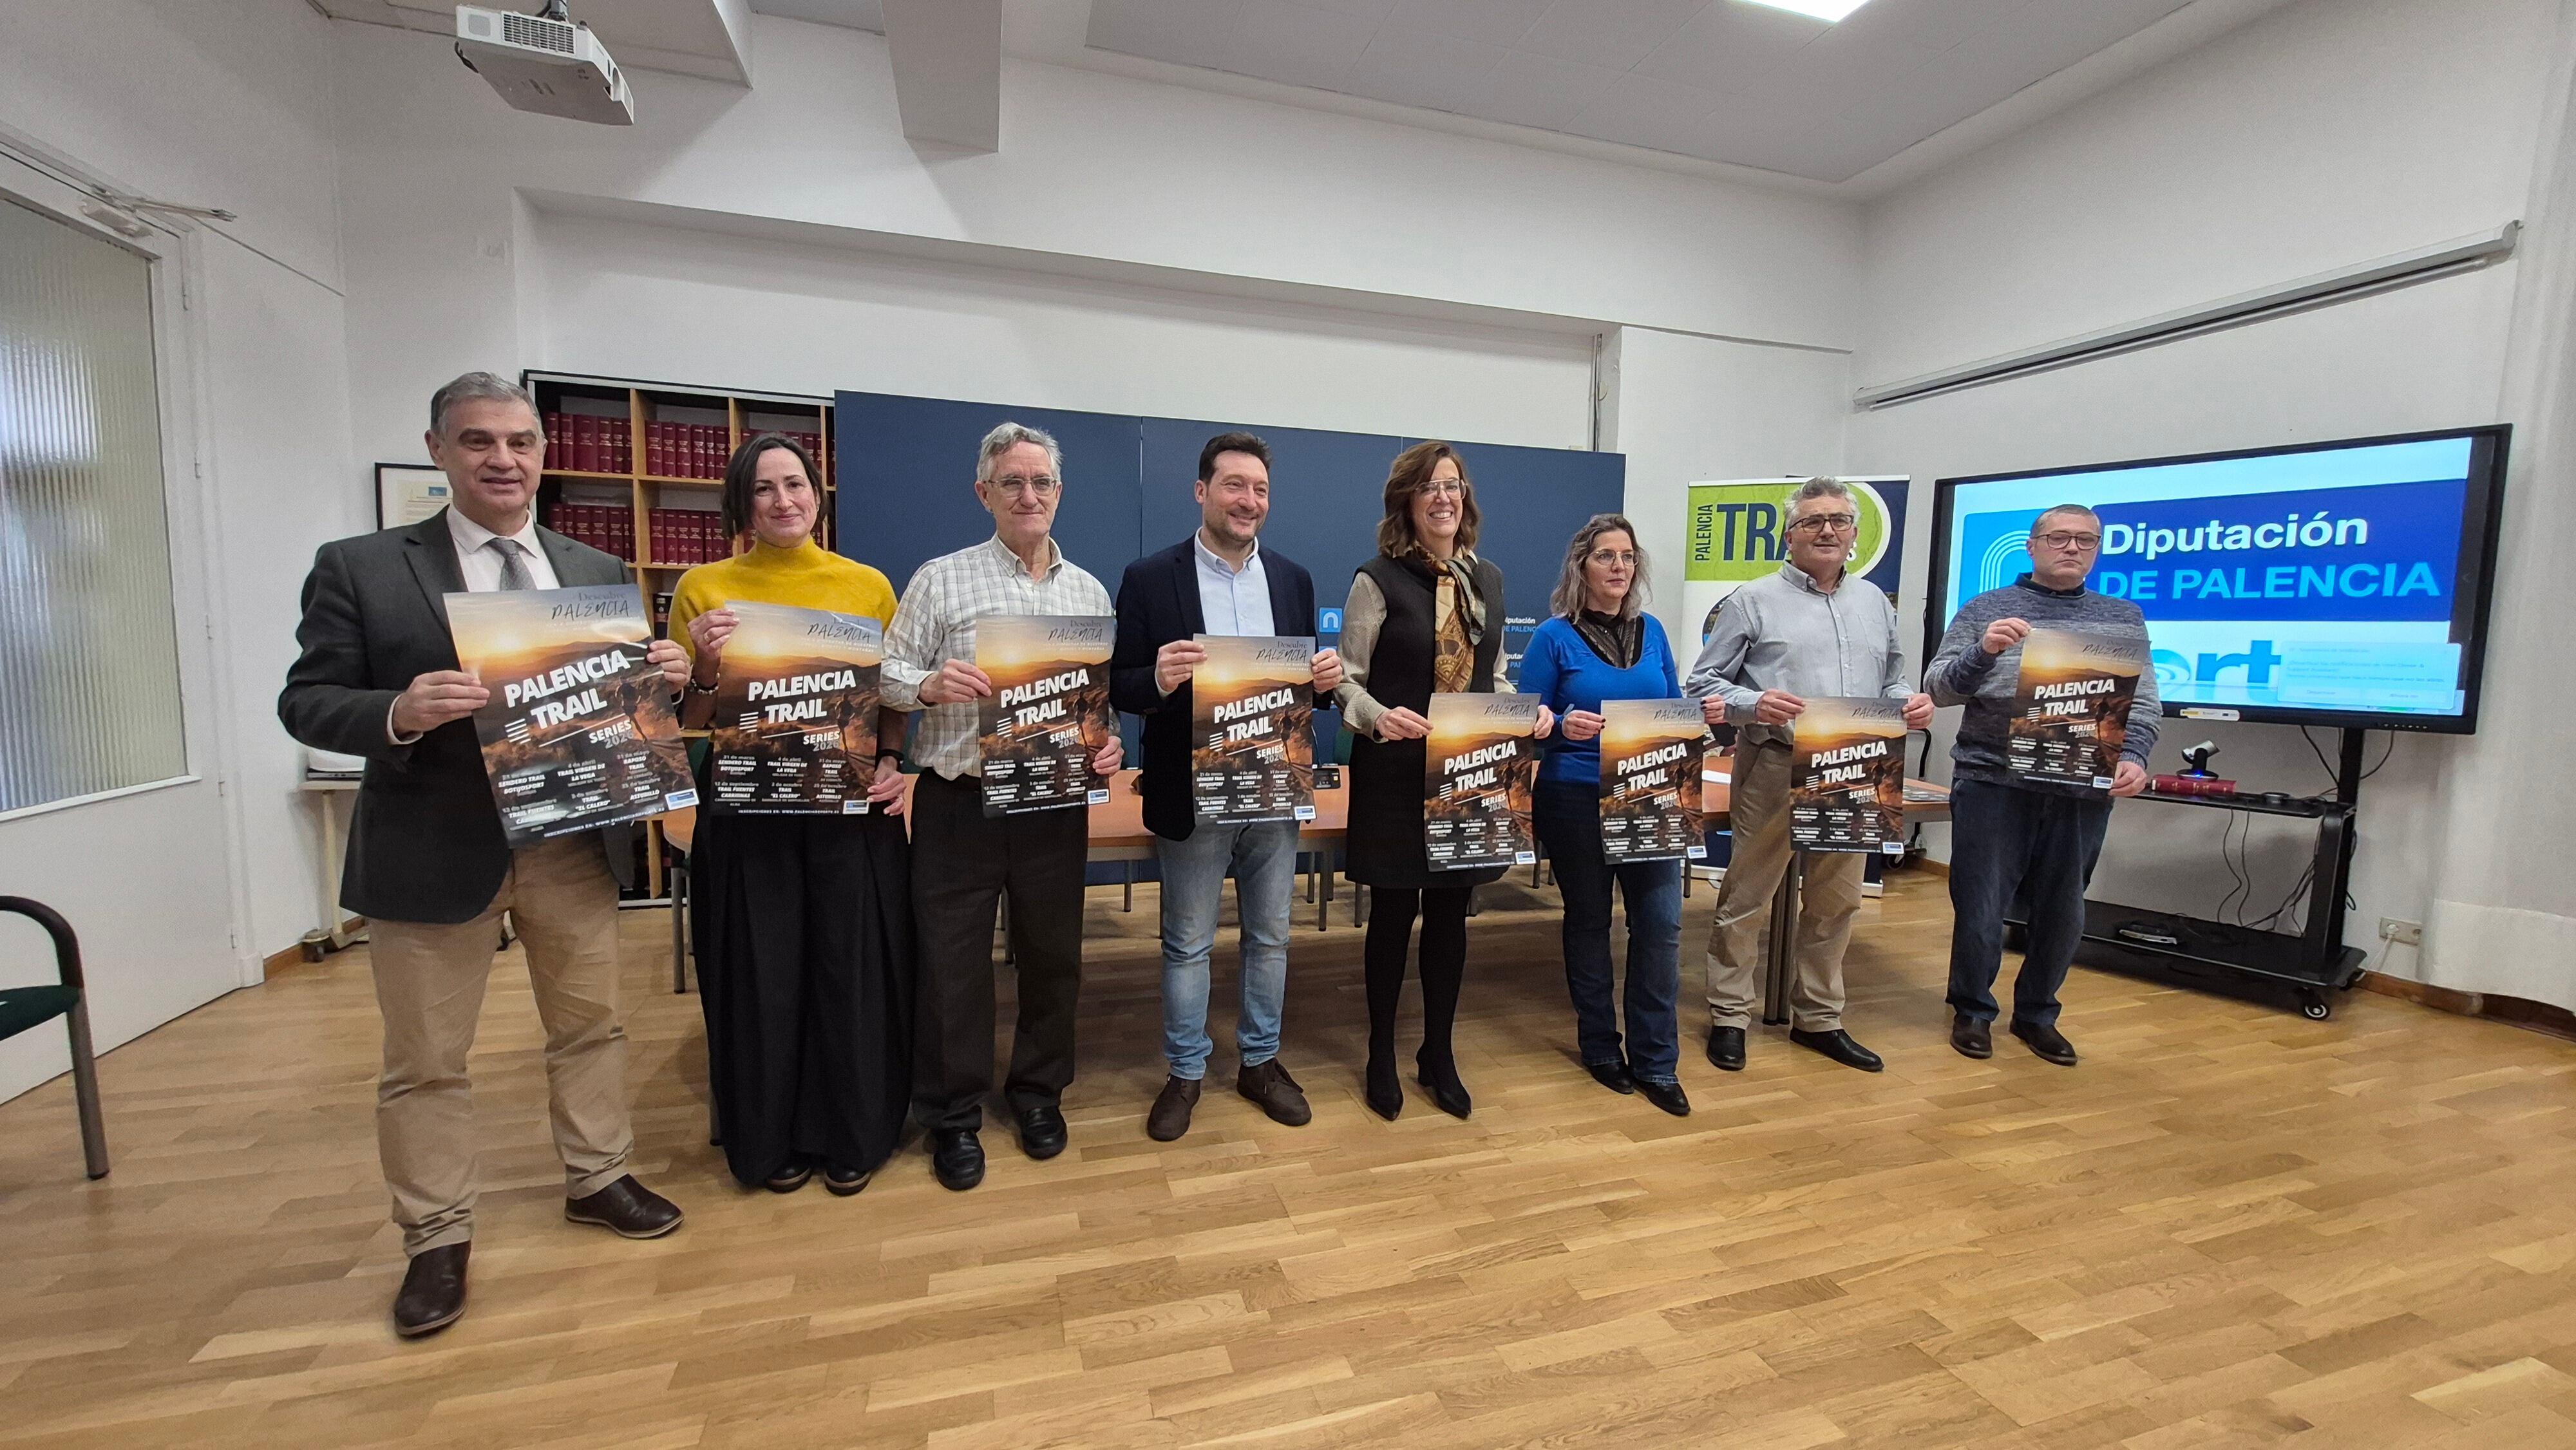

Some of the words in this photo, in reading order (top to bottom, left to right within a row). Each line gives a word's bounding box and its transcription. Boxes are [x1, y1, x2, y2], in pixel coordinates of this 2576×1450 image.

[1695, 504, 1713, 561] PALENCIA
[2102, 510, 2369, 560] Diputación
[2099, 568, 2157, 601] DE
[2172, 561, 2441, 599] PALENCIA
[504, 650, 631, 708] PALENCIA
[748, 670, 857, 702] PALENCIA
[1000, 668, 1090, 708] PALENCIA
[2034, 679, 2116, 700] PALENCIA
[531, 688, 608, 730] TRAIL
[764, 699, 828, 724] TRAIL
[1015, 698, 1067, 728] TRAIL
[1213, 687, 1294, 724] PALENCIA
[2044, 699, 2089, 717] TRAIL
[589, 719, 632, 744] SERIES
[603, 730, 634, 749] 2026
[803, 731, 840, 745] SERIES
[1049, 726, 1080, 744] SERIES
[1227, 716, 1273, 742] TRAIL
[2068, 723, 2097, 733] SERIES
[813, 742, 840, 752] 2026
[1256, 744, 1283, 759] SERIES
[1444, 740, 1517, 775] PALENCIA
[1617, 742, 1687, 776] PALENCIA
[1811, 740, 1888, 768] PALENCIA
[1455, 767, 1497, 793] TRAIL
[1627, 768, 1668, 792] TRAIL
[1822, 764, 1866, 785] TRAIL
[1481, 793, 1506, 807] SERIES
[1653, 792, 1678, 805] SERIES
[1848, 787, 1876, 800] SERIES
